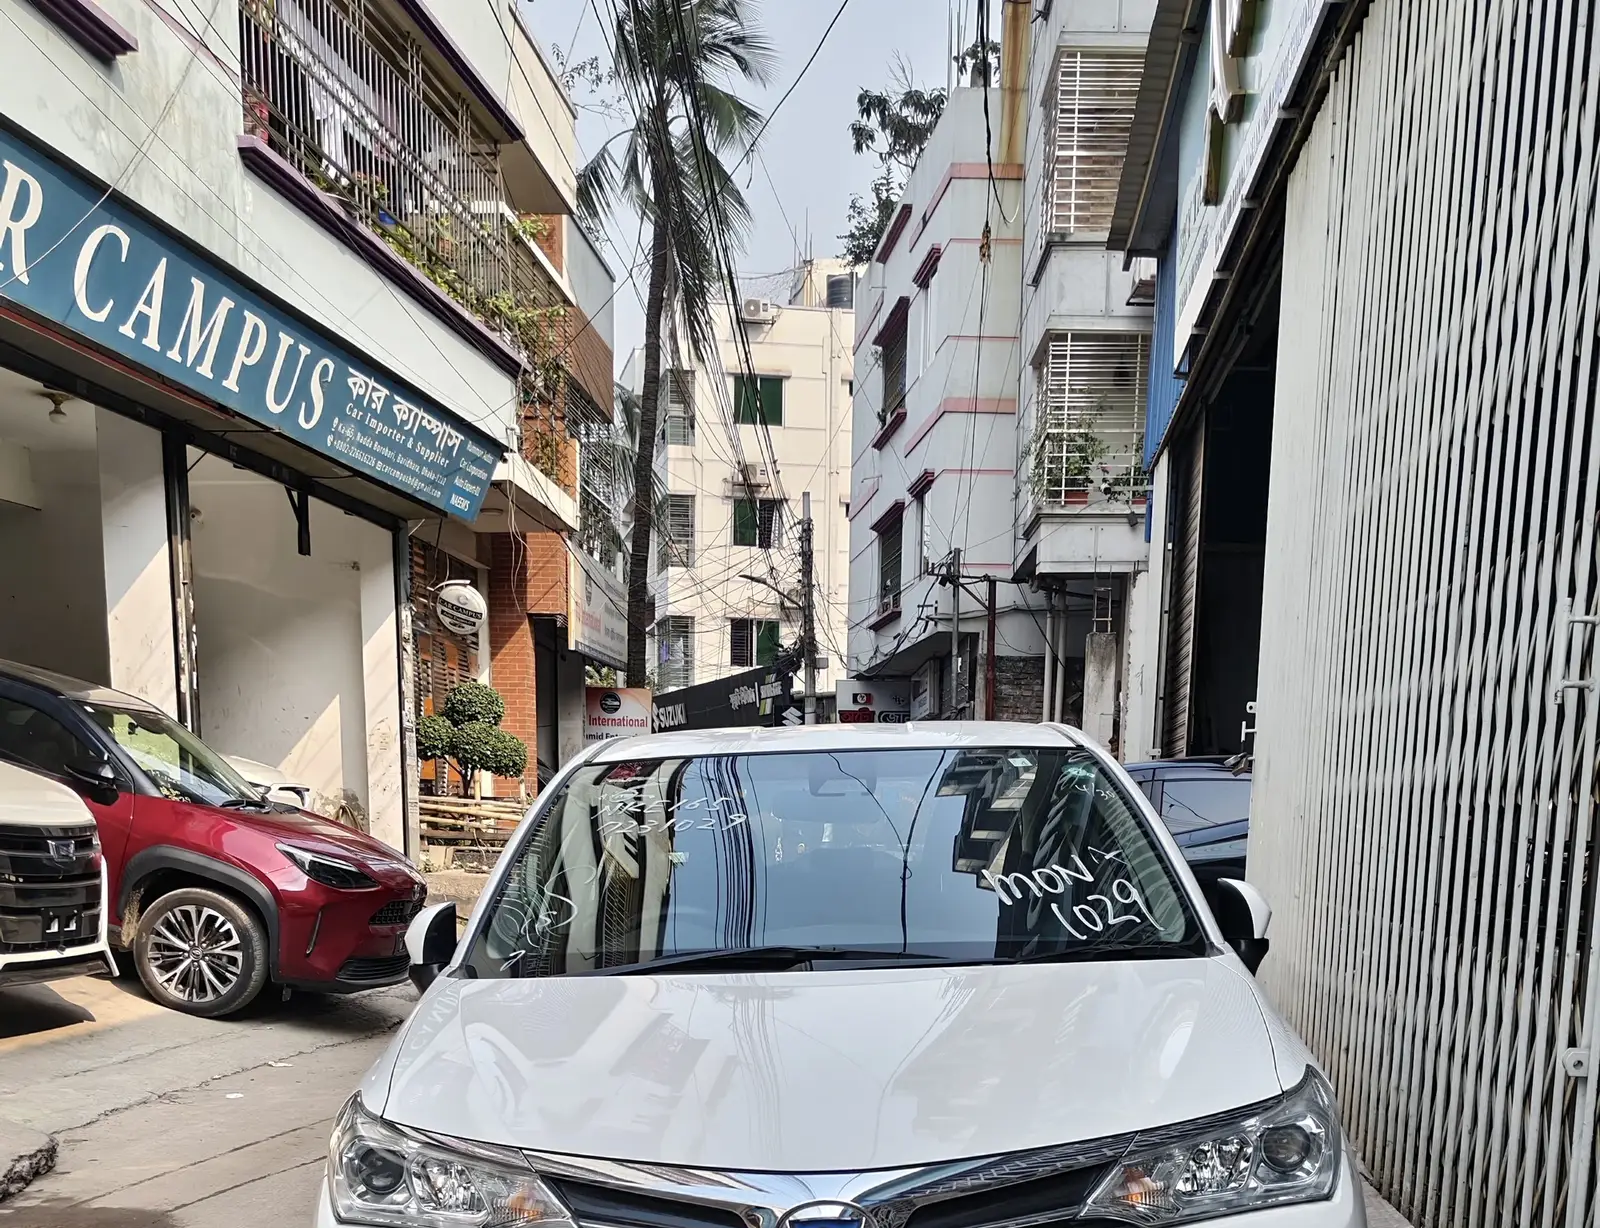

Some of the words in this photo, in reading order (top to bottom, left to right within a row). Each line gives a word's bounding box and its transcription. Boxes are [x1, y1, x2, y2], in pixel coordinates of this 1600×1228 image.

[73, 224, 335, 430] CAMPUS
[346, 403, 363, 420] Car
[365, 413, 406, 443] Importer
[407, 437, 414, 449] &
[415, 442, 450, 468] Supplier
[347, 366, 390, 414] কার
[393, 394, 465, 457] ক্যাম্পাস
[439, 598, 453, 610] CAR
[453, 605, 482, 619] CAMPUS
[588, 714, 648, 728] International
[660, 703, 688, 728] SUZUKI
[1050, 878, 1166, 940] 1029
